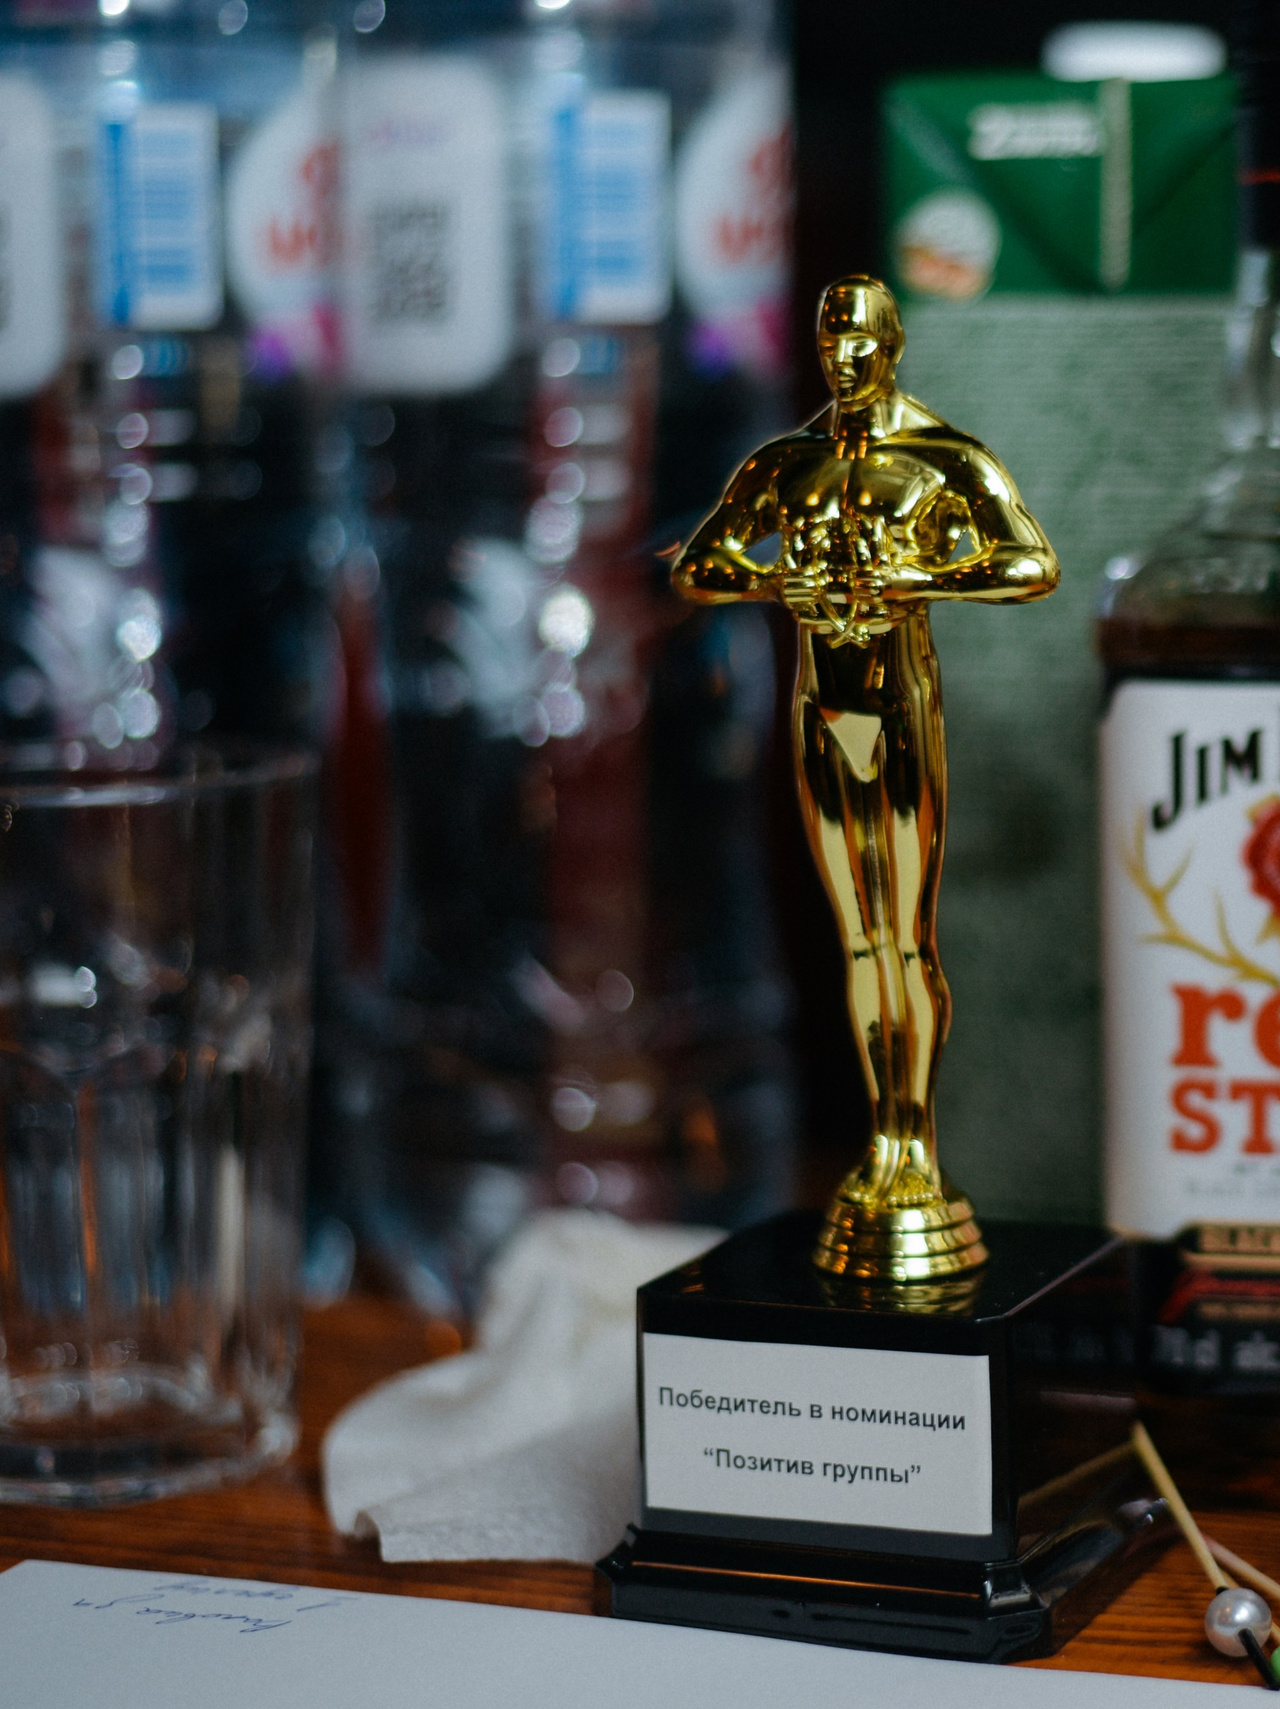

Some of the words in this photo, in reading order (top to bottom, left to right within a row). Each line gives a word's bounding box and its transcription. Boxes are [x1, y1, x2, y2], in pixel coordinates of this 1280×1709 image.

[1151, 728, 1264, 831] JIM
[659, 1386, 801, 1417] Победитель
[810, 1402, 823, 1418] в
[832, 1406, 966, 1431] номинации
[704, 1448, 814, 1476] “Позитив
[823, 1460, 921, 1485] группы”
